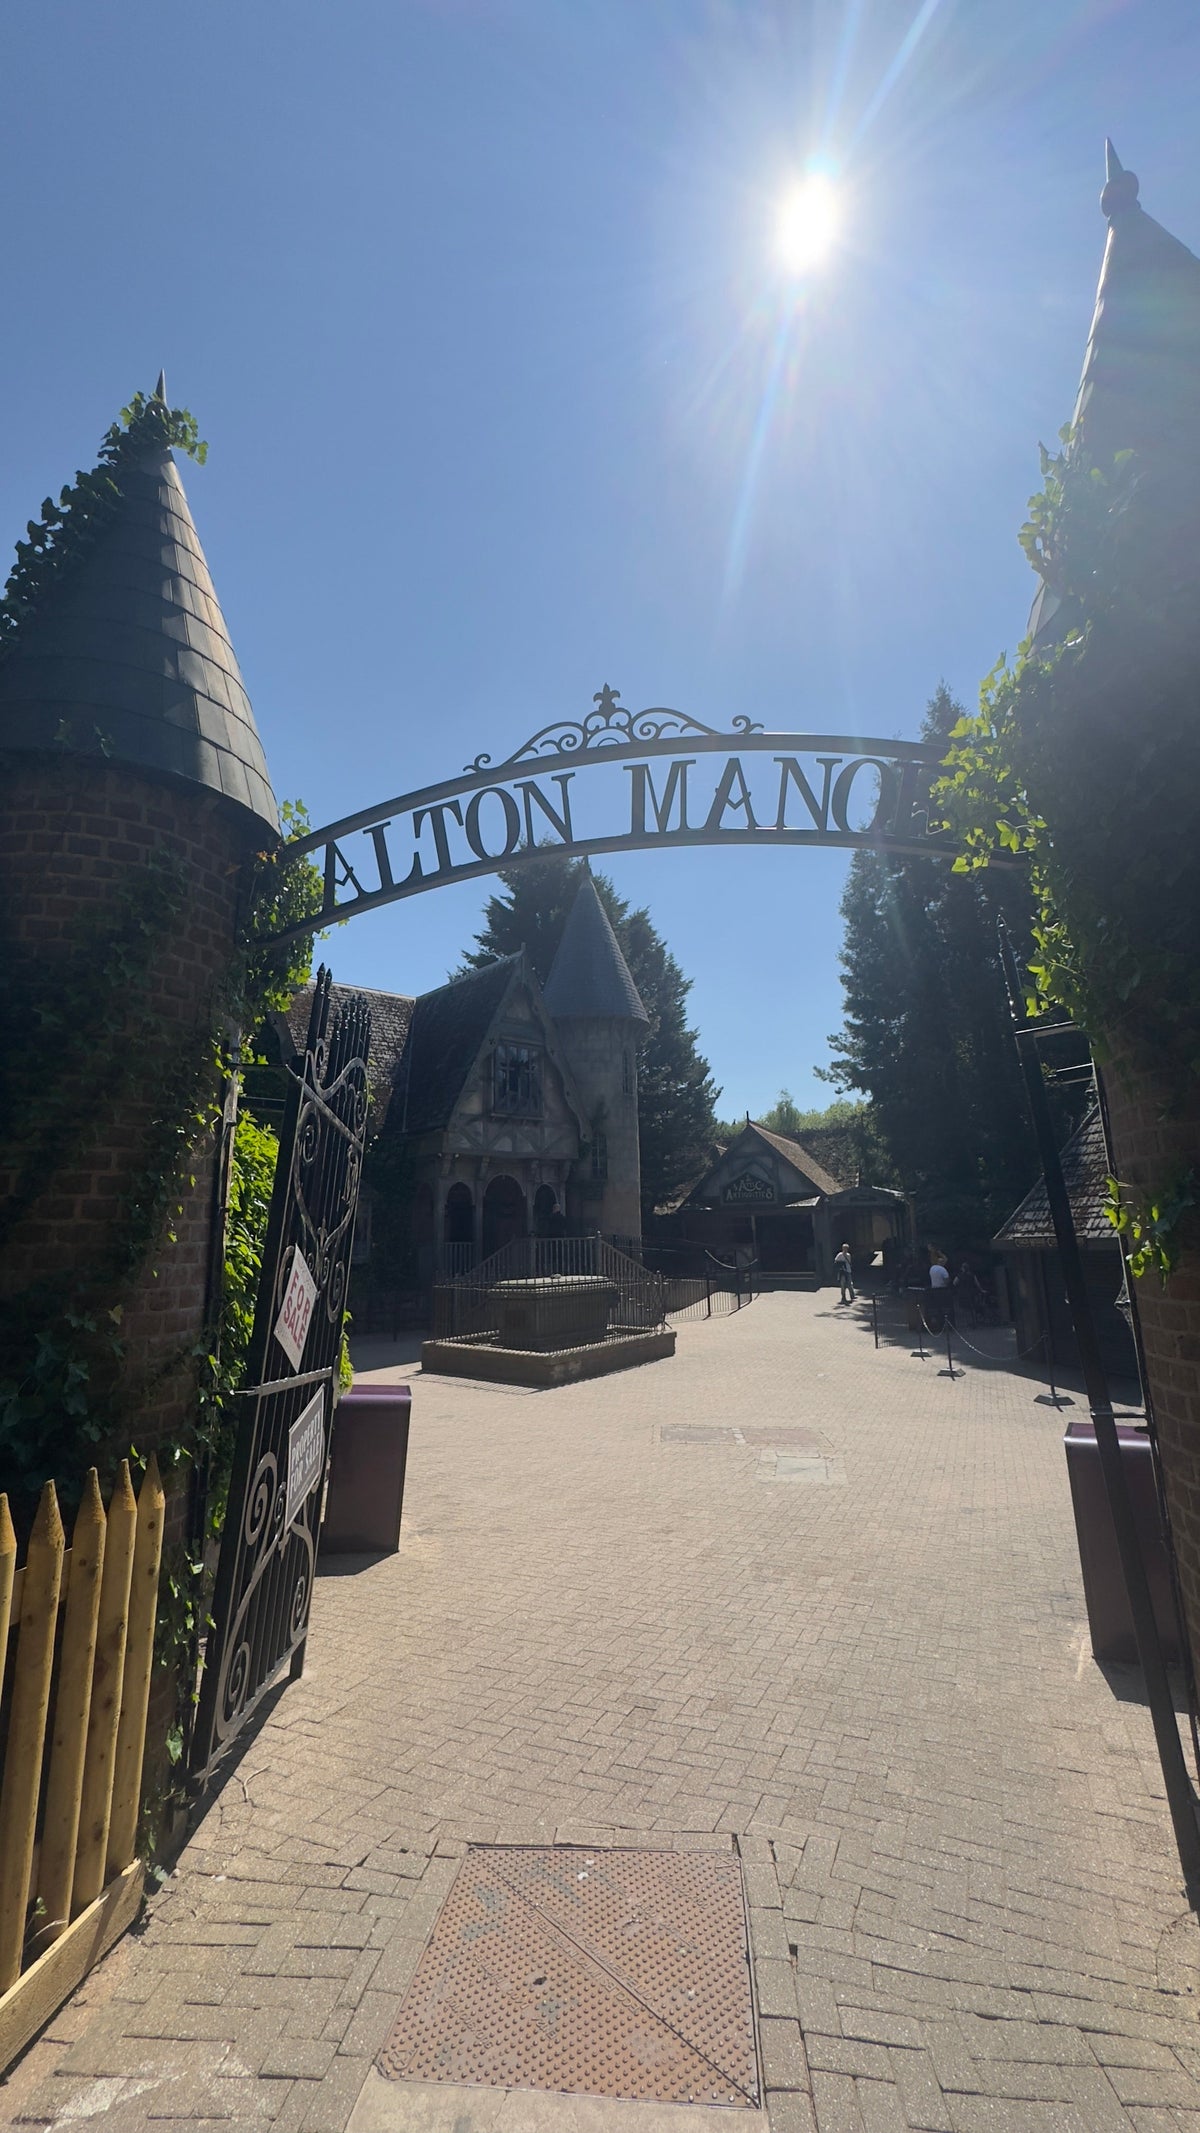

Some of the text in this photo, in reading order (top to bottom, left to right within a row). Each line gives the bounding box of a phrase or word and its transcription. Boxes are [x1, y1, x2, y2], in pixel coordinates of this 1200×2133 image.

[323, 772, 576, 907] ALTON
[283, 1295, 307, 1350] SALE
[290, 1269, 311, 1324] FOR
[291, 1410, 321, 1472] PROPERTY
[289, 1460, 304, 1499] FOR
